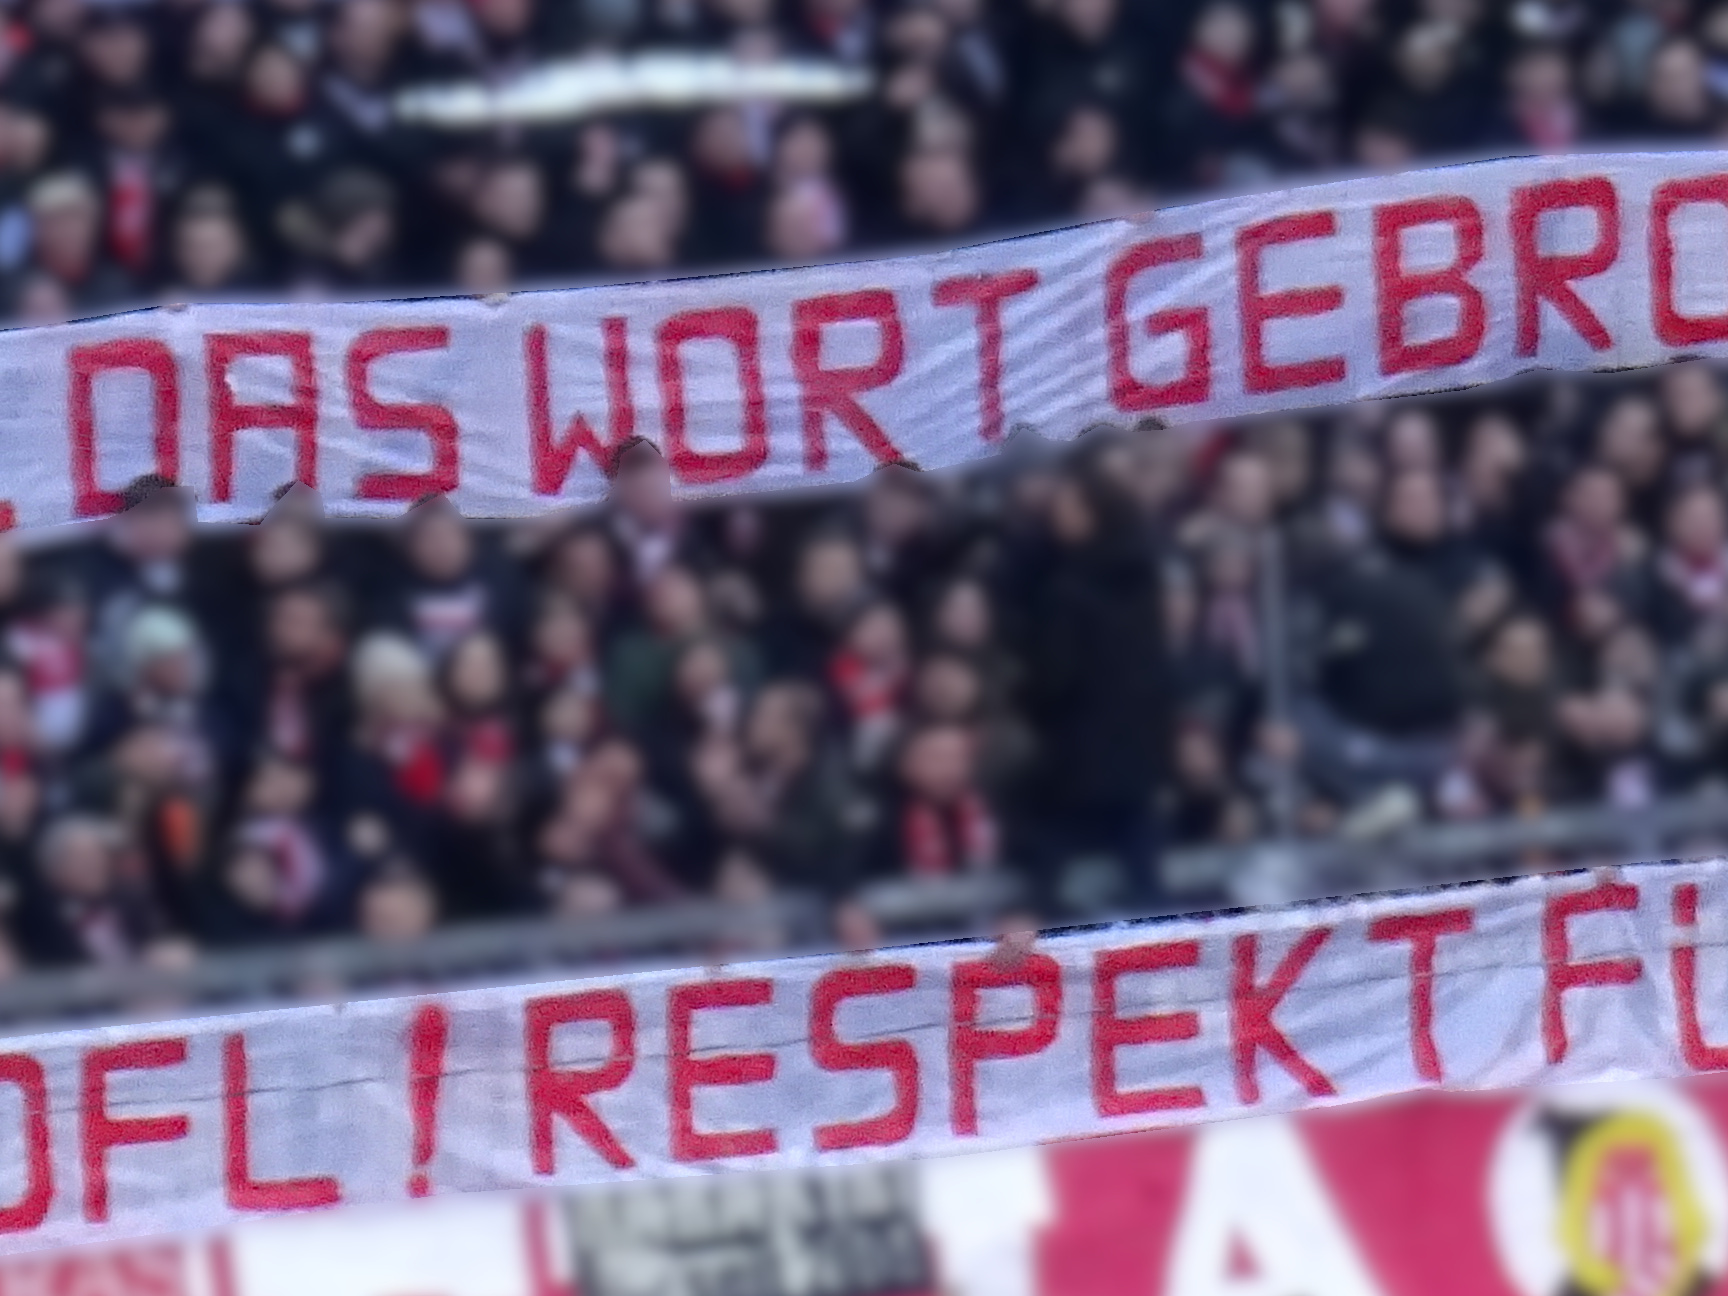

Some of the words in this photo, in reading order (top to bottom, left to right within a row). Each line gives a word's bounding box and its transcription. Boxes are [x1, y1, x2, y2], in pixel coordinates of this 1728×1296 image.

[67, 323, 462, 518] DAS
[523, 266, 1039, 500] WORT
[521, 906, 1474, 1178] RESPEKT
